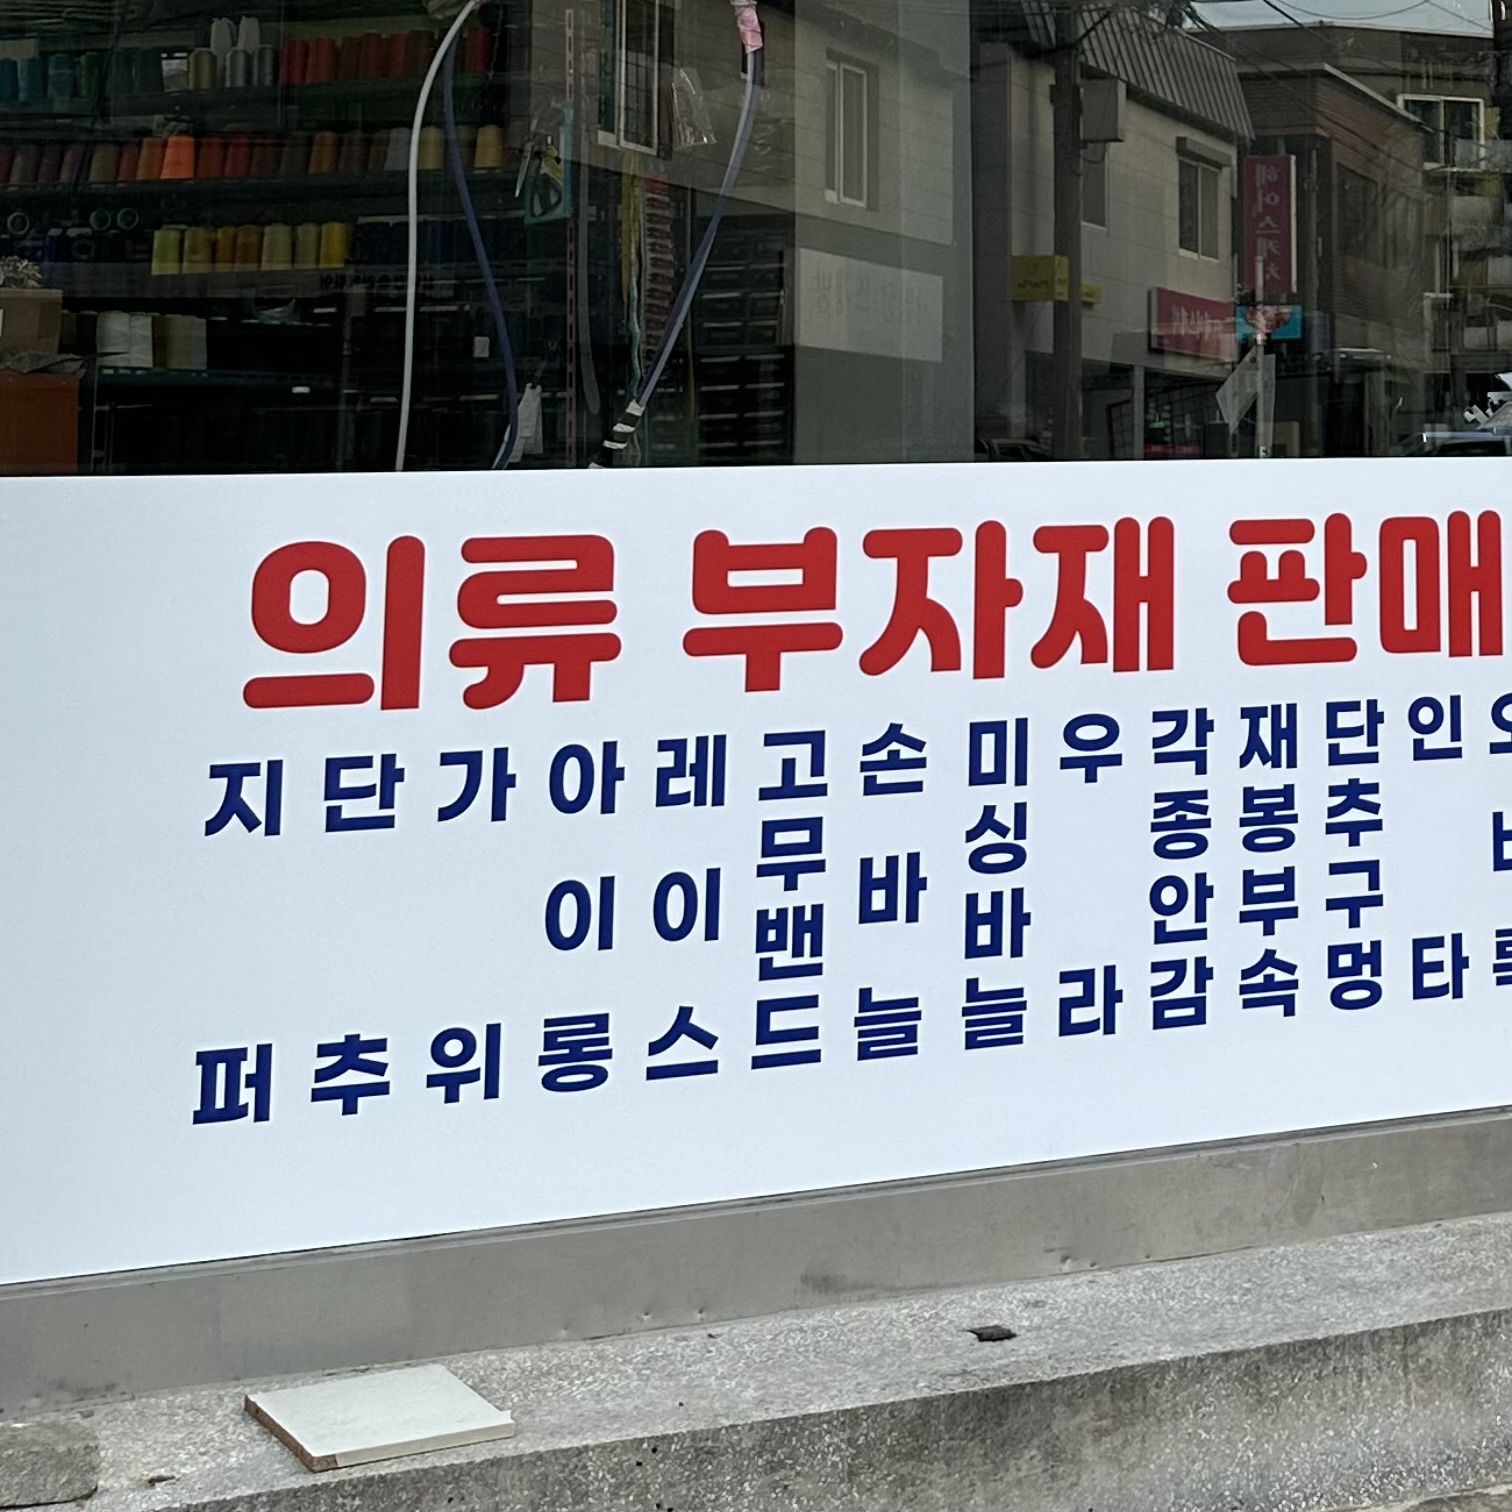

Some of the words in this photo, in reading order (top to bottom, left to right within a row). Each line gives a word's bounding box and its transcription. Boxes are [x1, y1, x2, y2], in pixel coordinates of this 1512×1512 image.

[242, 534, 622, 711] 의류
[681, 515, 1175, 692] 부자재
[1227, 510, 1504, 667] 판매
[750, 729, 828, 1071] 고무밴드
[961, 717, 1032, 1051] 미싱바늘
[1148, 707, 1215, 1031] 각종안감
[1238, 702, 1300, 1019] 재봉부속
[1325, 698, 1385, 1012] 단추구멍
